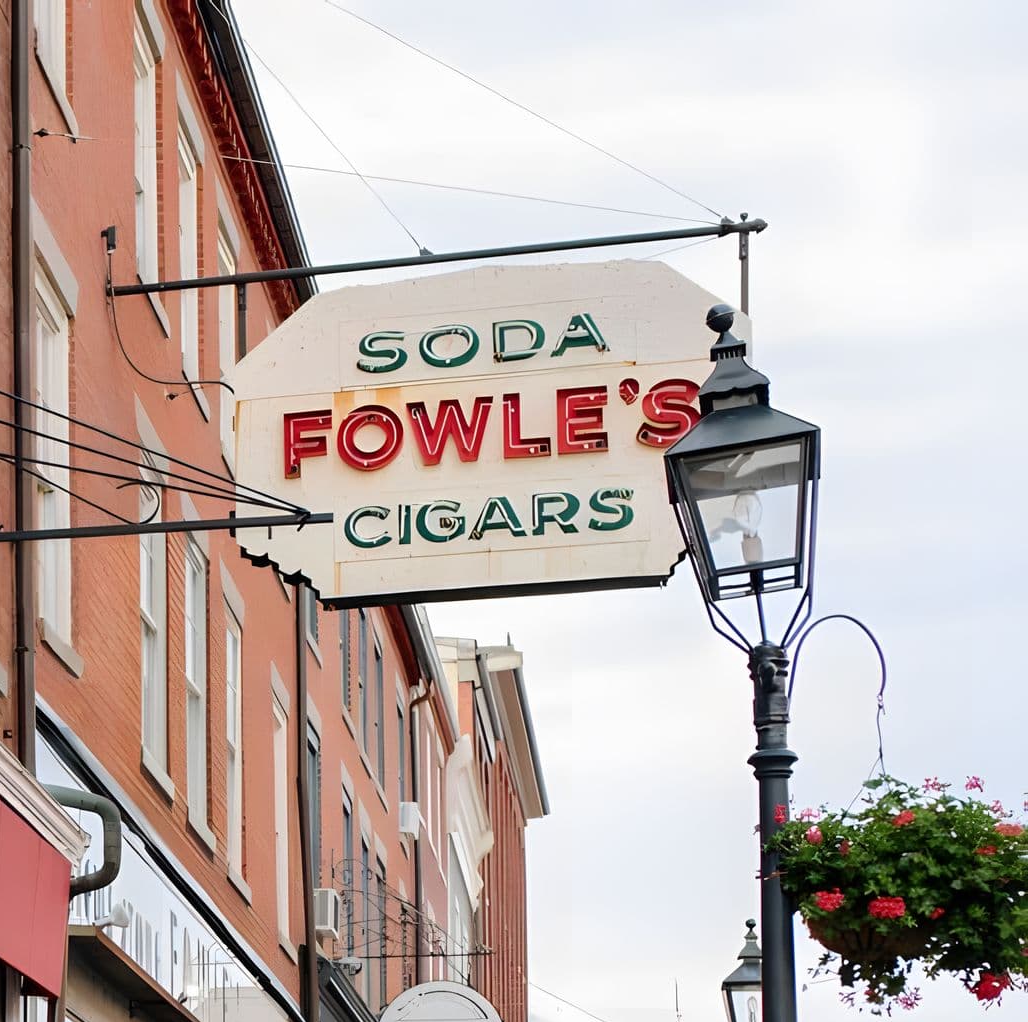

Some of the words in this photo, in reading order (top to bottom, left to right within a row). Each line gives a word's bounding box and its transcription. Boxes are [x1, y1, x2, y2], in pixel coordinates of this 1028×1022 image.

[356, 312, 610, 373] SODA
[283, 378, 704, 479] FOWLE'S
[344, 487, 634, 548] CIGARS
